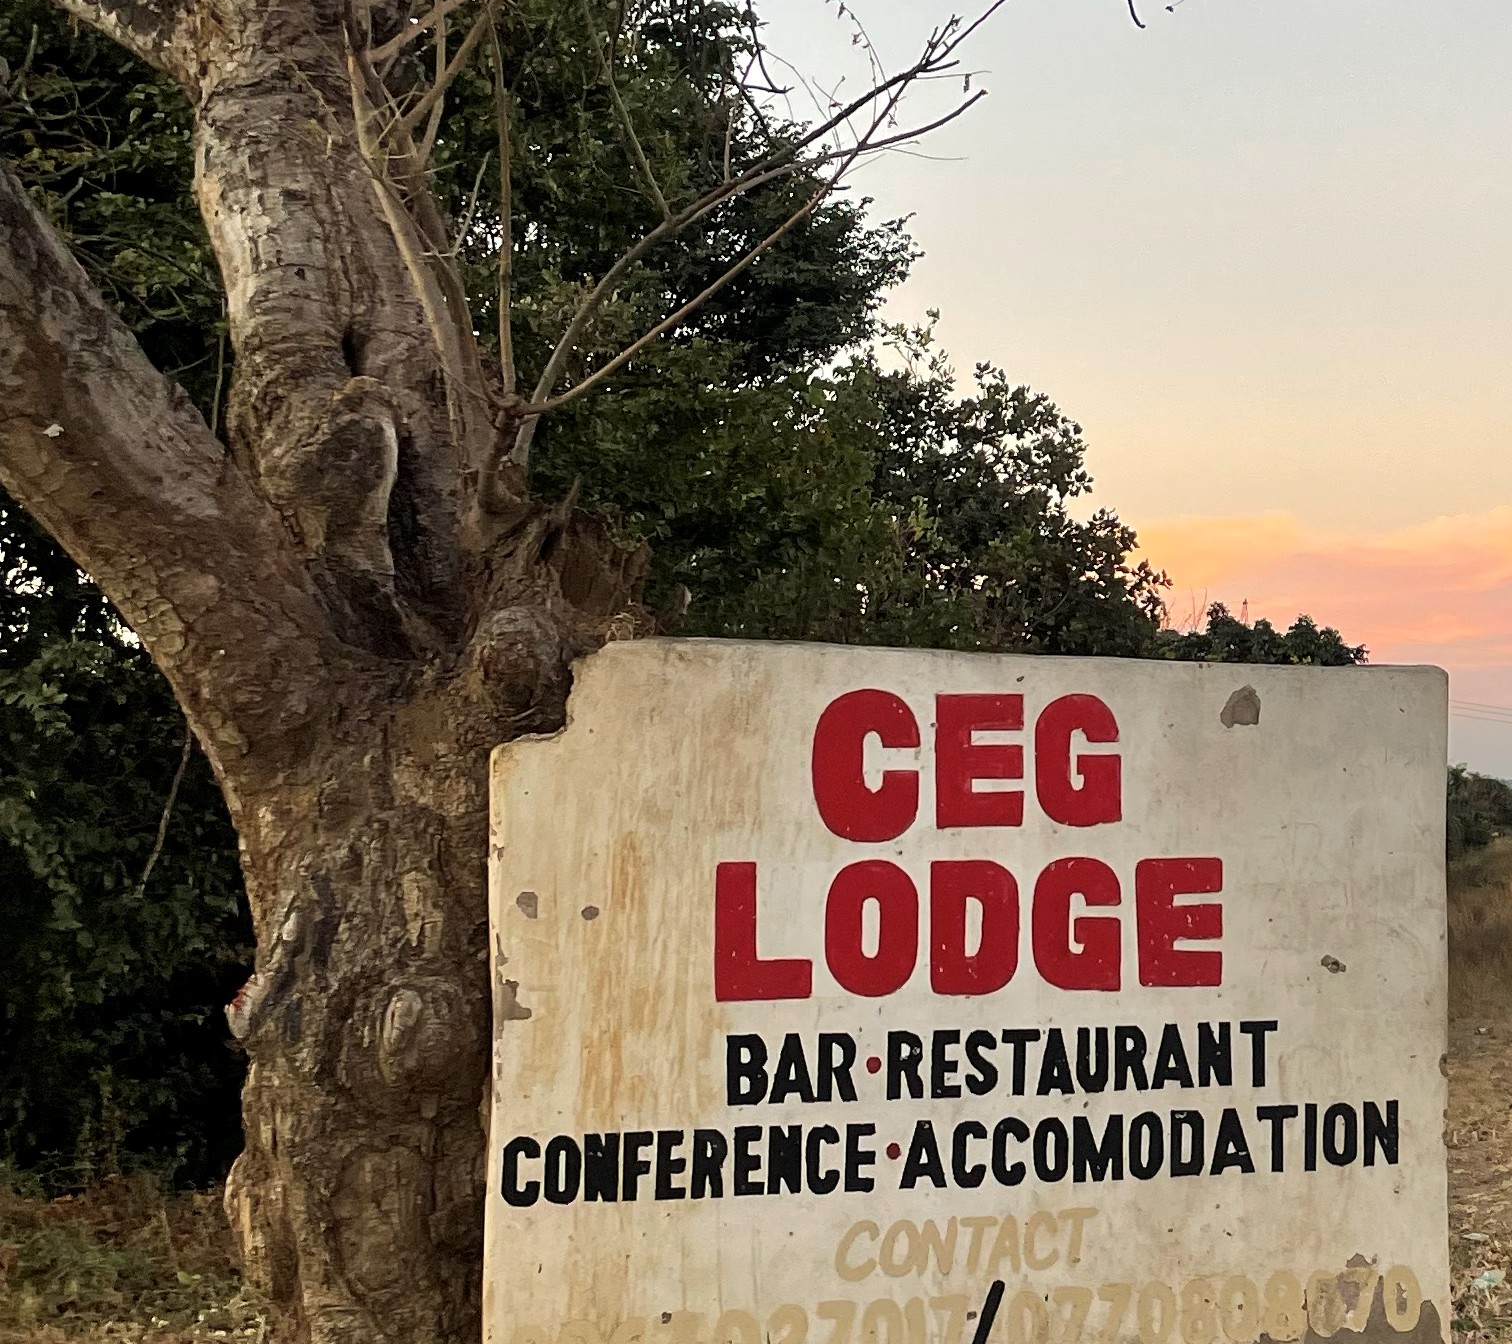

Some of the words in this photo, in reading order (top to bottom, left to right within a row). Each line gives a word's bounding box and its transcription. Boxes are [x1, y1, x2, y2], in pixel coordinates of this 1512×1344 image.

[811, 688, 1122, 843] CEG
[714, 856, 1224, 1002] LODGE
[834, 1207, 1099, 1283] CONTACT
